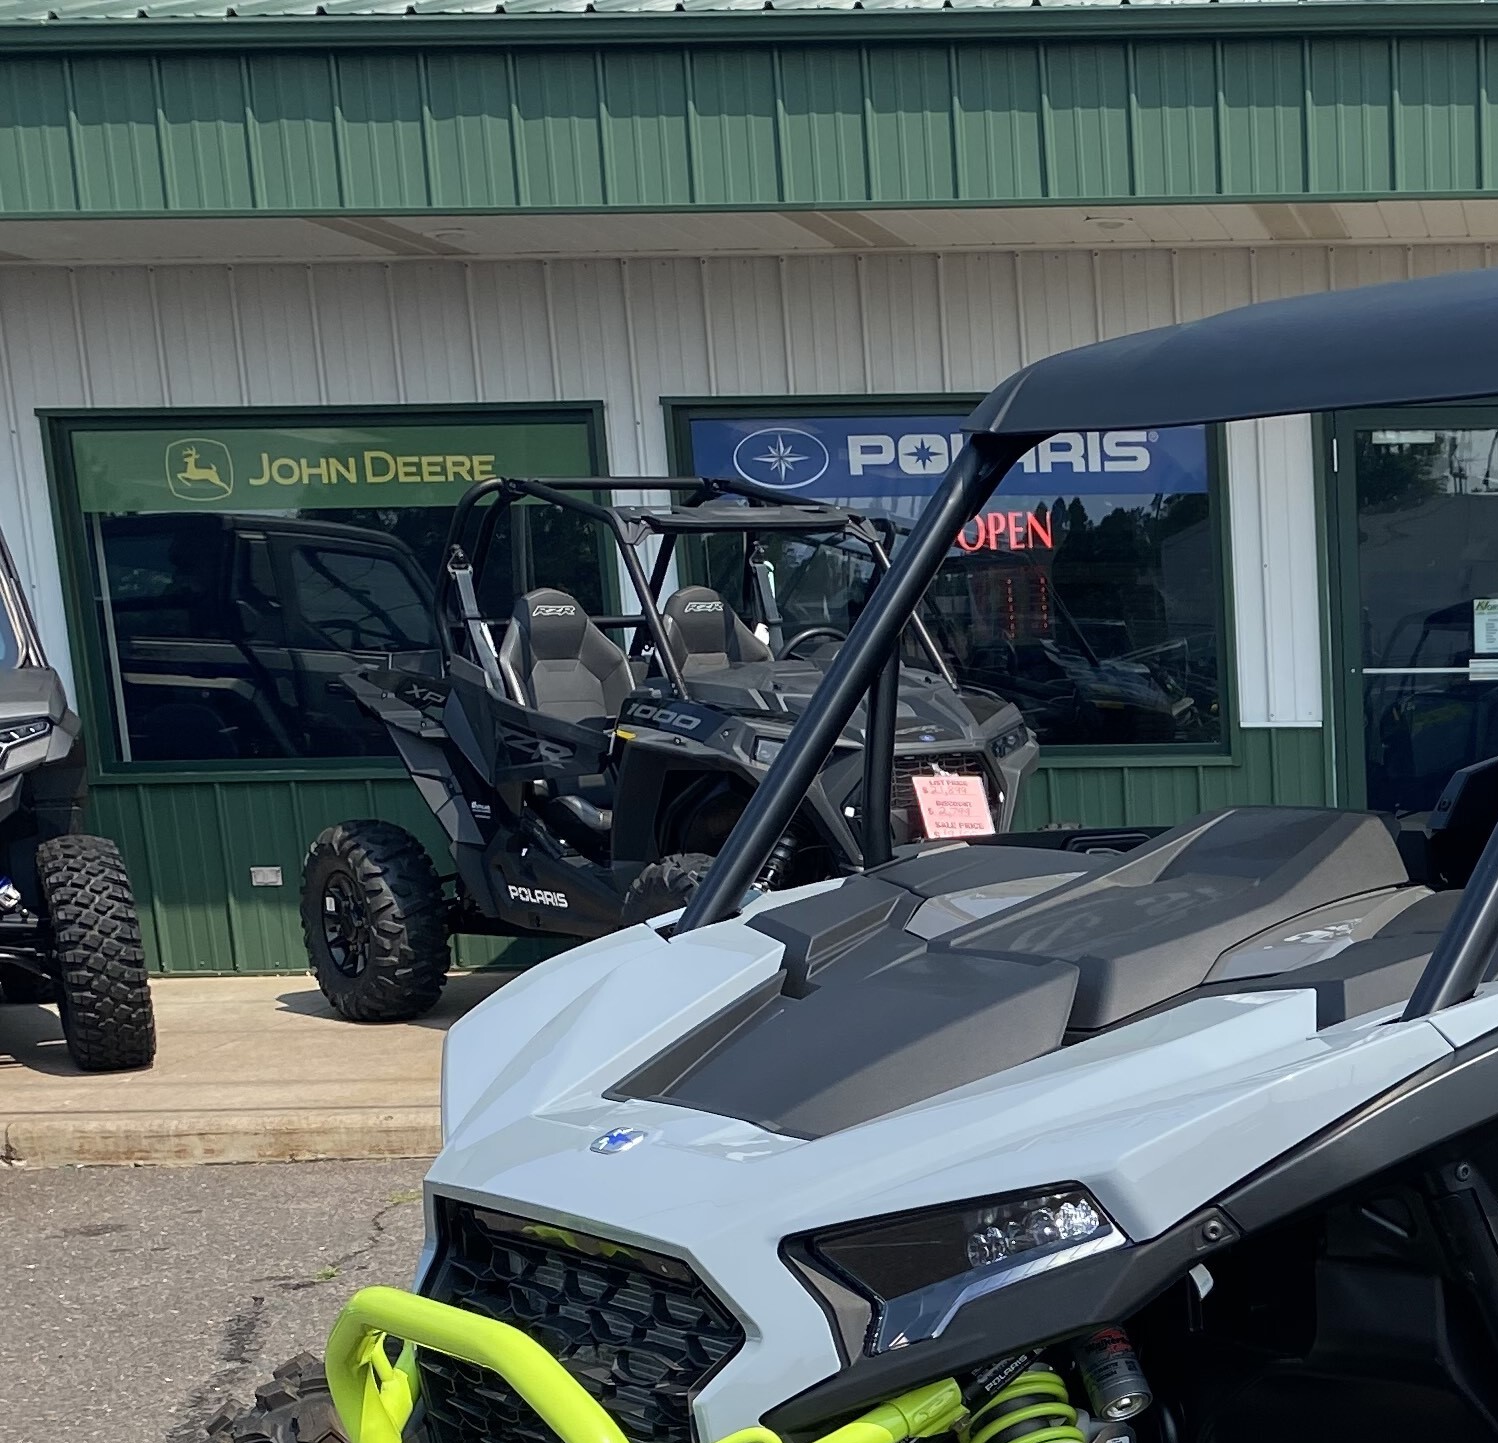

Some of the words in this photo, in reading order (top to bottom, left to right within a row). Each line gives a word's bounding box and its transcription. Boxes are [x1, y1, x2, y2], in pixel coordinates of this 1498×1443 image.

[249, 452, 357, 486] JOHN
[363, 450, 497, 484] DEERE
[847, 431, 1151, 476] PORIS
[957, 511, 1053, 552] OPEN
[532, 604, 576, 617] RZR
[404, 684, 446, 704] XP
[626, 702, 702, 730] 1000
[507, 884, 569, 909] POLARIS
[984, 1354, 1029, 1392] POLARIS
